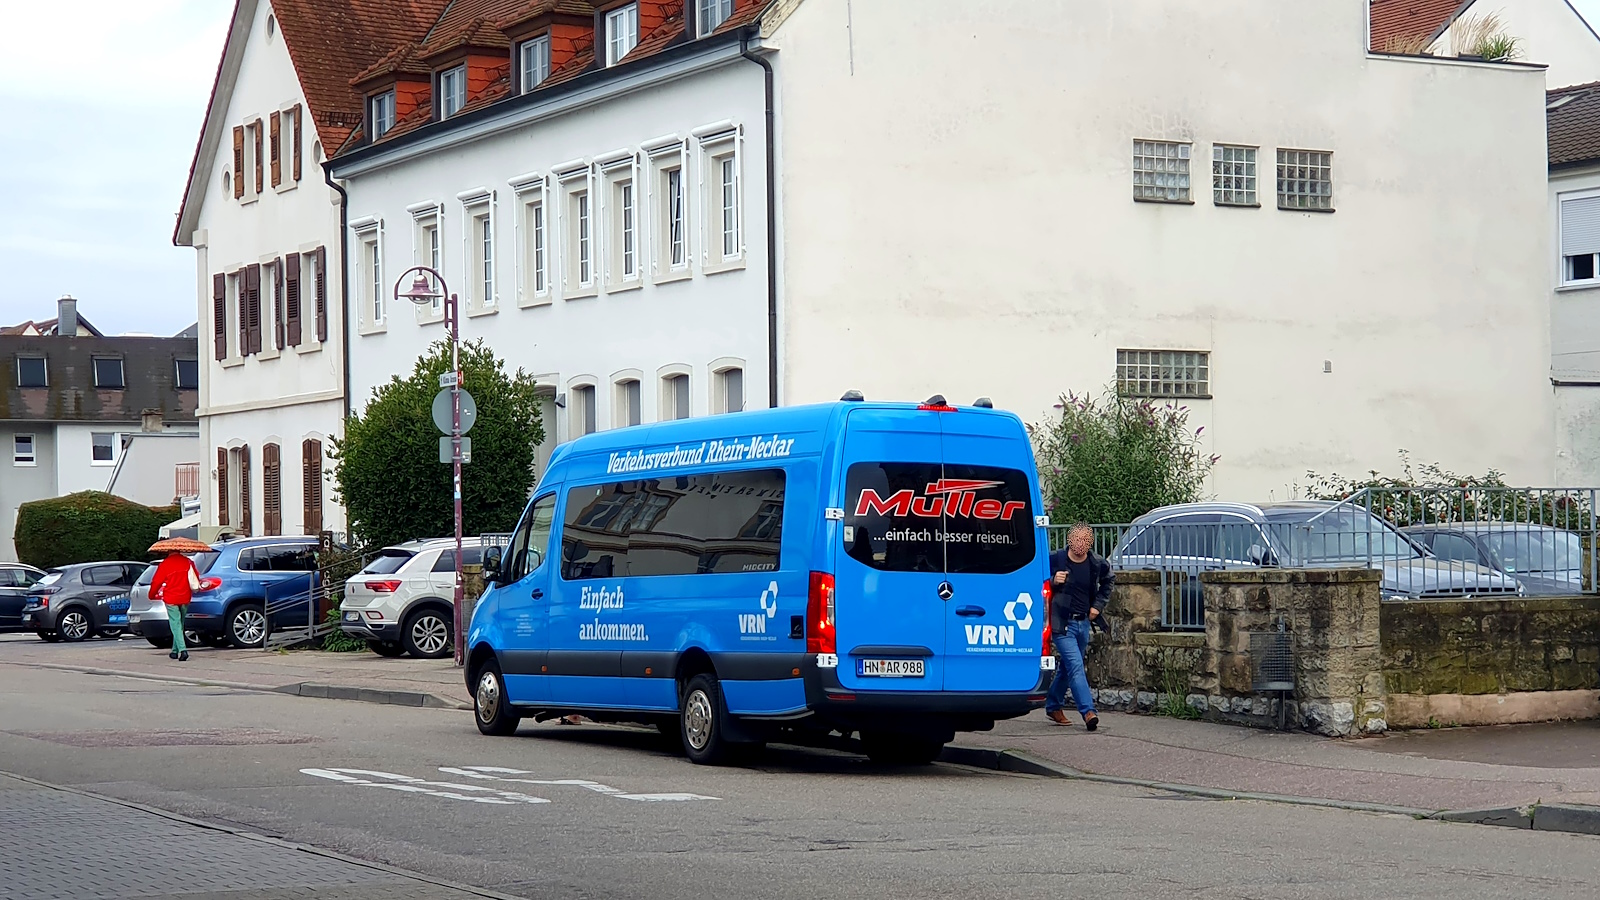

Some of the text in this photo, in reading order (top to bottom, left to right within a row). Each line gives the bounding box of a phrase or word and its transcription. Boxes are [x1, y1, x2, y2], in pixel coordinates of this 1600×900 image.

[606, 434, 795, 474] Verkehrsverbund Rhein-Neckar
[935, 529, 973, 544] besser
[976, 531, 1013, 545] reisen.
[742, 563, 777, 571] MIDCITY
[579, 586, 624, 614] Einfach
[579, 618, 649, 641] ankommen.
[738, 614, 766, 634] VRN
[964, 624, 1015, 646] VRN
[864, 661, 923, 674] HN AR 988
